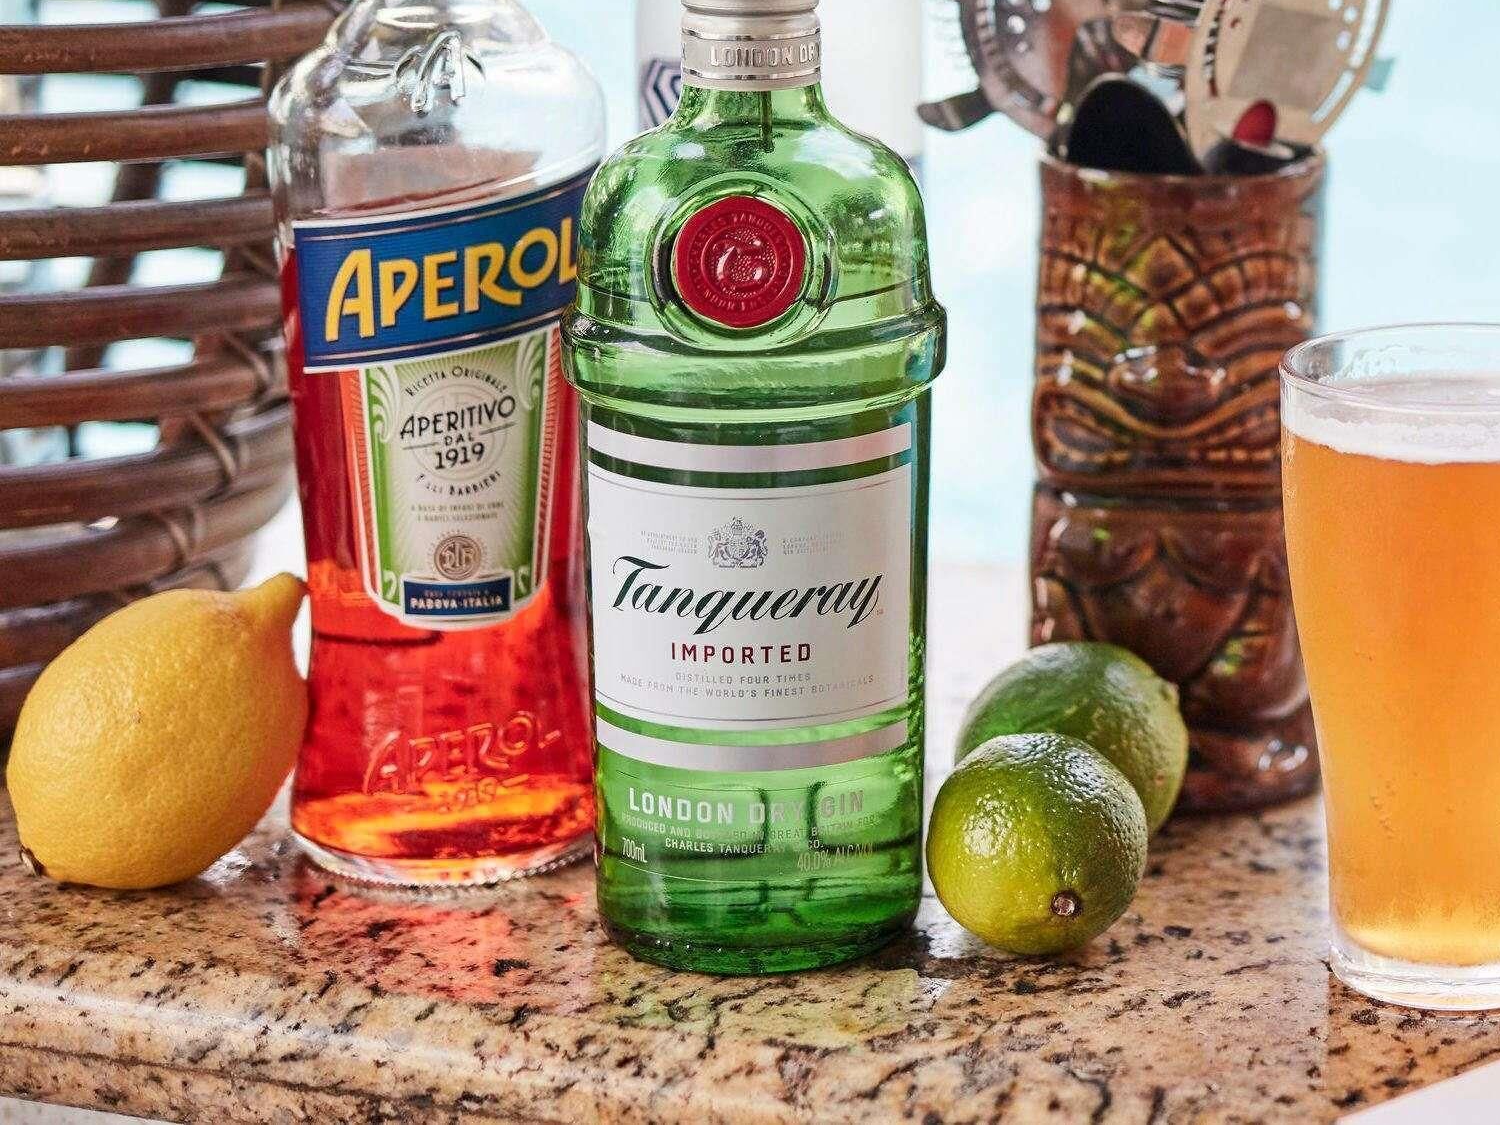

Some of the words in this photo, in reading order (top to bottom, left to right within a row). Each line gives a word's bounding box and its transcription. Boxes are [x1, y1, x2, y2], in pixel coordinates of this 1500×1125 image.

[710, 44, 794, 68] LONDON
[325, 216, 578, 343] APEROL
[400, 395, 516, 440] APERITIVO
[443, 432, 475, 447] DAL
[434, 441, 485, 470] 1919
[612, 555, 884, 636] Tanqueray
[671, 642, 812, 665] IMPORTED
[675, 672, 733, 685] DISTILLED
[739, 675, 770, 685] FOUR
[776, 673, 811, 684] TIMES
[678, 686, 699, 696] THE
[705, 688, 757, 698] WORLD'S
[764, 686, 806, 698] FINEST
[629, 786, 734, 825] LONDON
[820, 788, 865, 819] GIN
[664, 837, 714, 853] CHARLES
